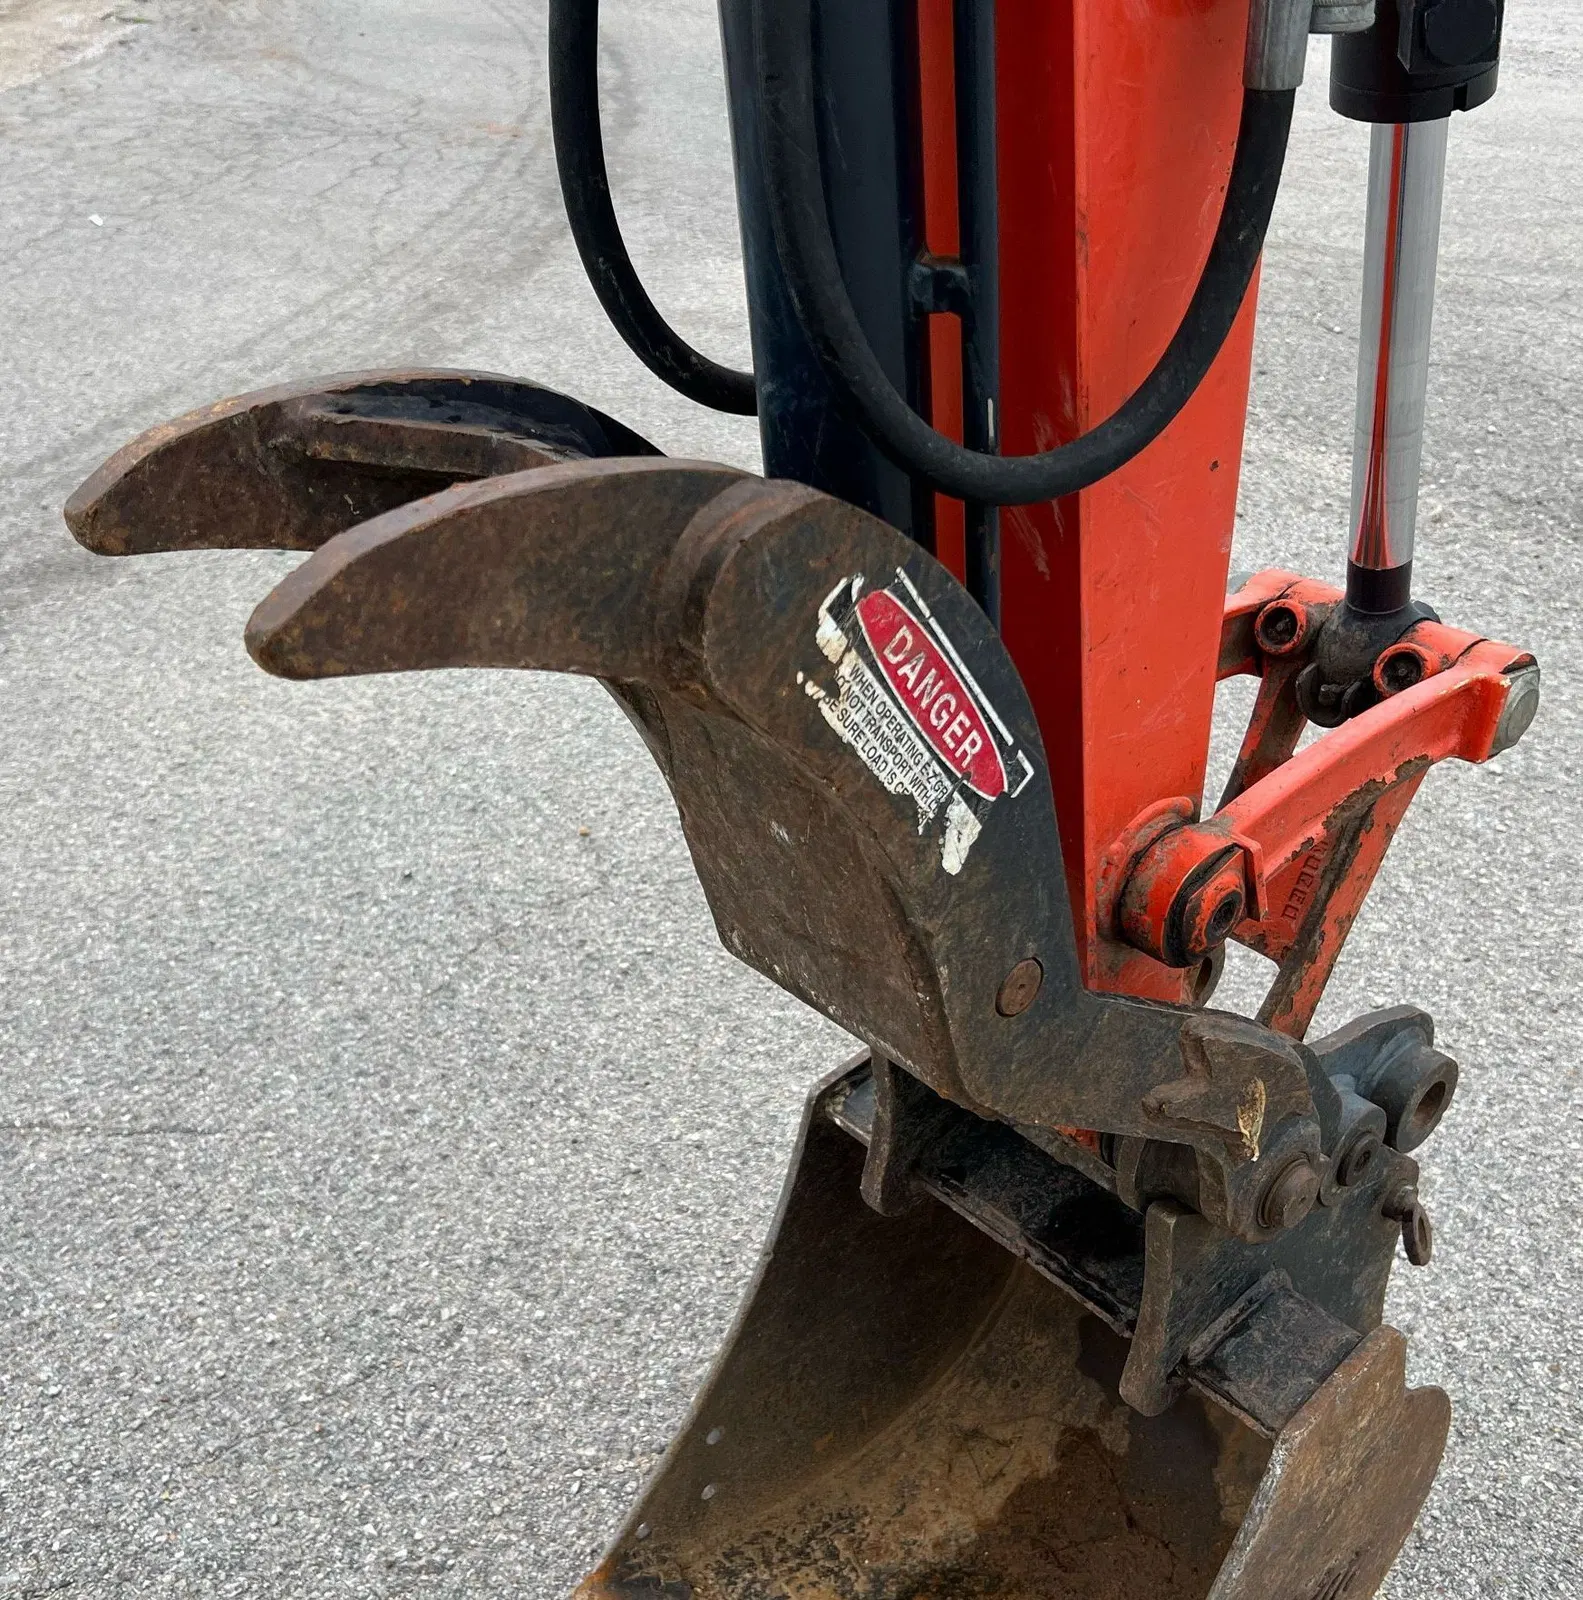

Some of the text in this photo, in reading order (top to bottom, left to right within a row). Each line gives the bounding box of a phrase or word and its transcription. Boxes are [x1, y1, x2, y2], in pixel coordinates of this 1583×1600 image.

[837, 708, 865, 744] SURE
[862, 740, 888, 773] LOAD
[885, 769, 897, 785] IS
[843, 685, 866, 715] NOT
[862, 709, 911, 778] TRANSPORT
[910, 774, 930, 803] WITH
[850, 664, 879, 705] WHEN
[875, 701, 923, 765] OPERATING
[920, 762, 939, 784] E-Z
[884, 625, 982, 767] DANGER
